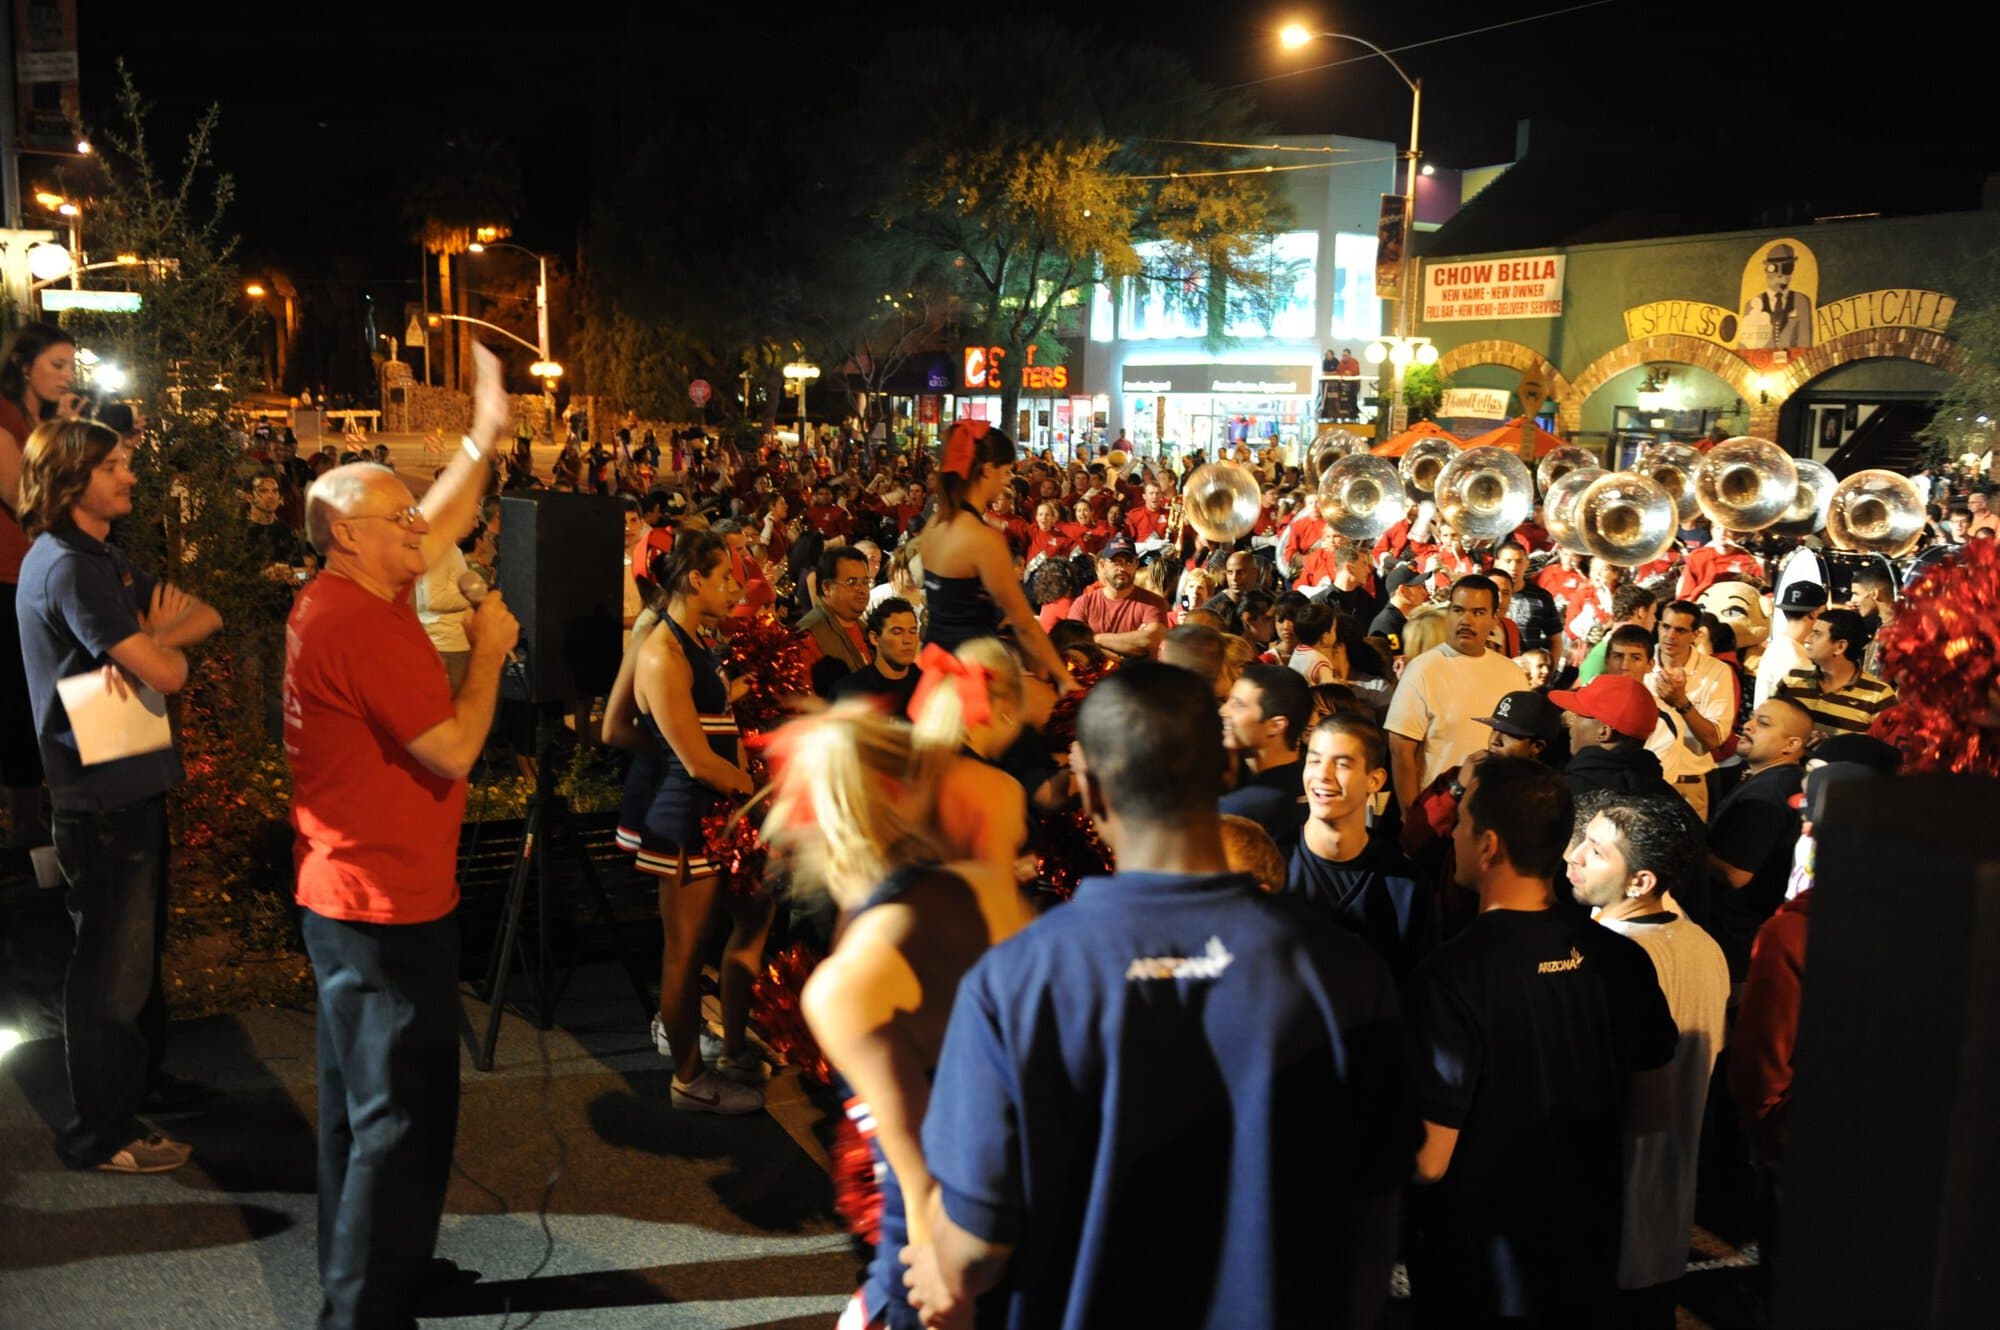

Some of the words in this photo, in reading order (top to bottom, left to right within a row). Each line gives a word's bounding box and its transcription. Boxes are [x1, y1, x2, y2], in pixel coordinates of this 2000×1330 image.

[1434, 264, 1493, 286] CHOW
[1498, 260, 1556, 282] BELLA
[1442, 289, 1459, 301] NEW
[1461, 287, 1485, 300] NAME
[1490, 286, 1510, 299] NEW
[1513, 284, 1545, 298] OWNER
[1497, 302, 1528, 315] DELIVERY
[1531, 300, 1562, 313] SERVICE
[1627, 301, 1738, 343] ESPRESSO
[988, 365, 1067, 389] CTERS
[1792, 591, 1801, 602] P
[1387, 634, 1399, 650] 3
[1538, 959, 1577, 973] ARIZONA
